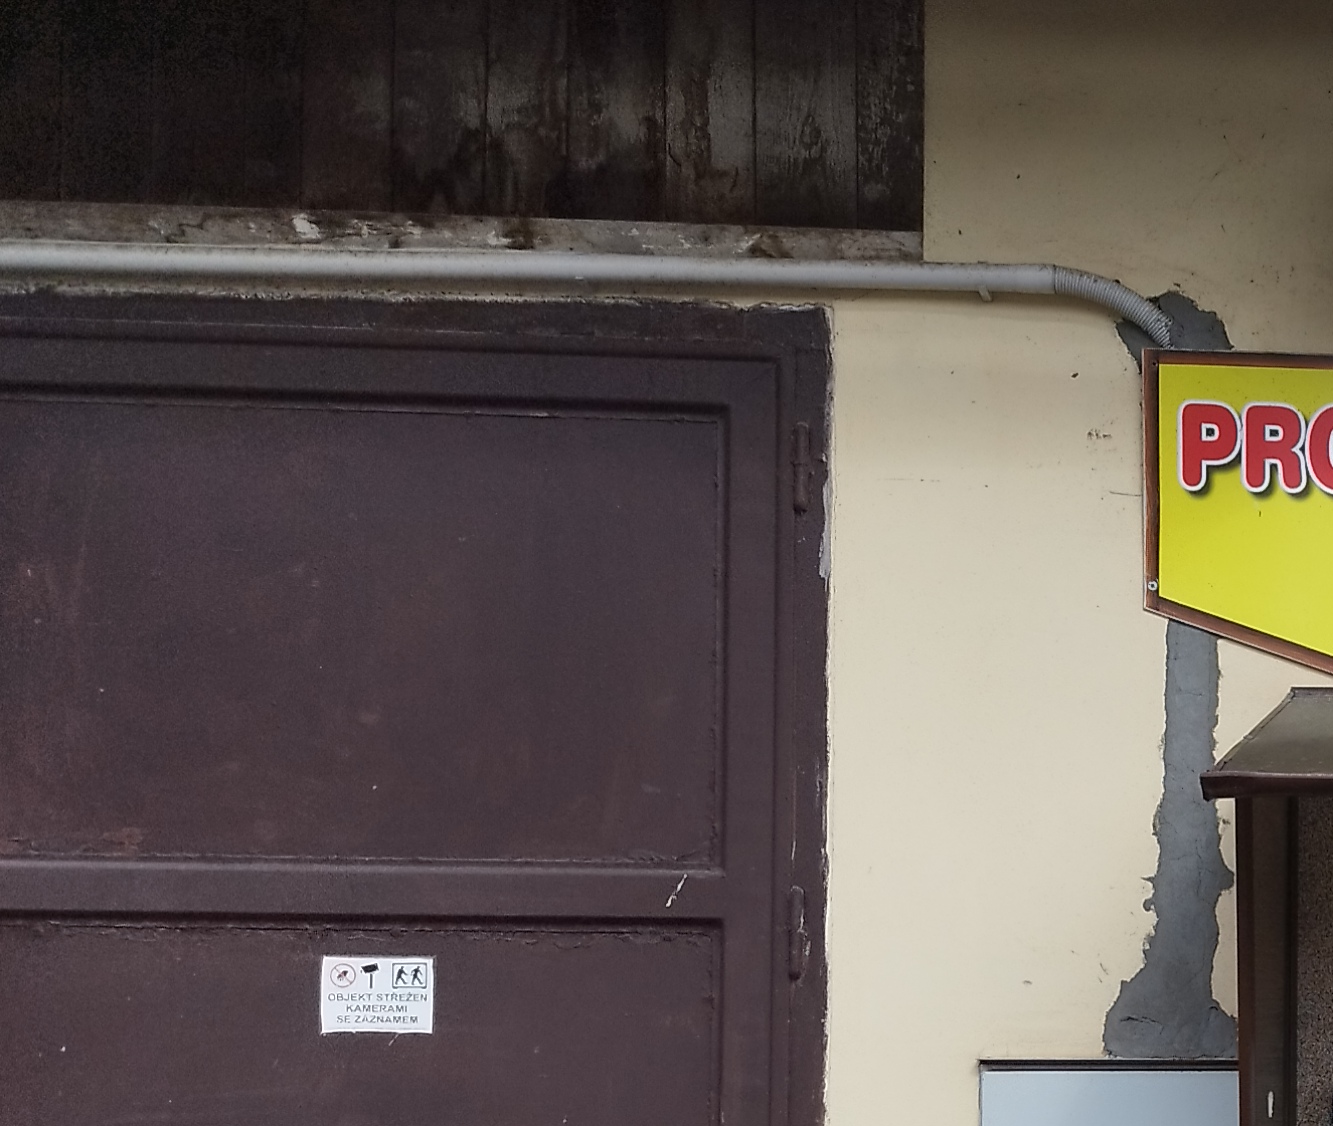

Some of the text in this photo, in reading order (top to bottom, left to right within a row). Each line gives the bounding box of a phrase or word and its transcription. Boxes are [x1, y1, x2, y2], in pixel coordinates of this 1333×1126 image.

[328, 991, 428, 1002] OBJEKT STŘEŽEN
[346, 1004, 408, 1012] KAMERAMI
[336, 1015, 351, 1024] SE
